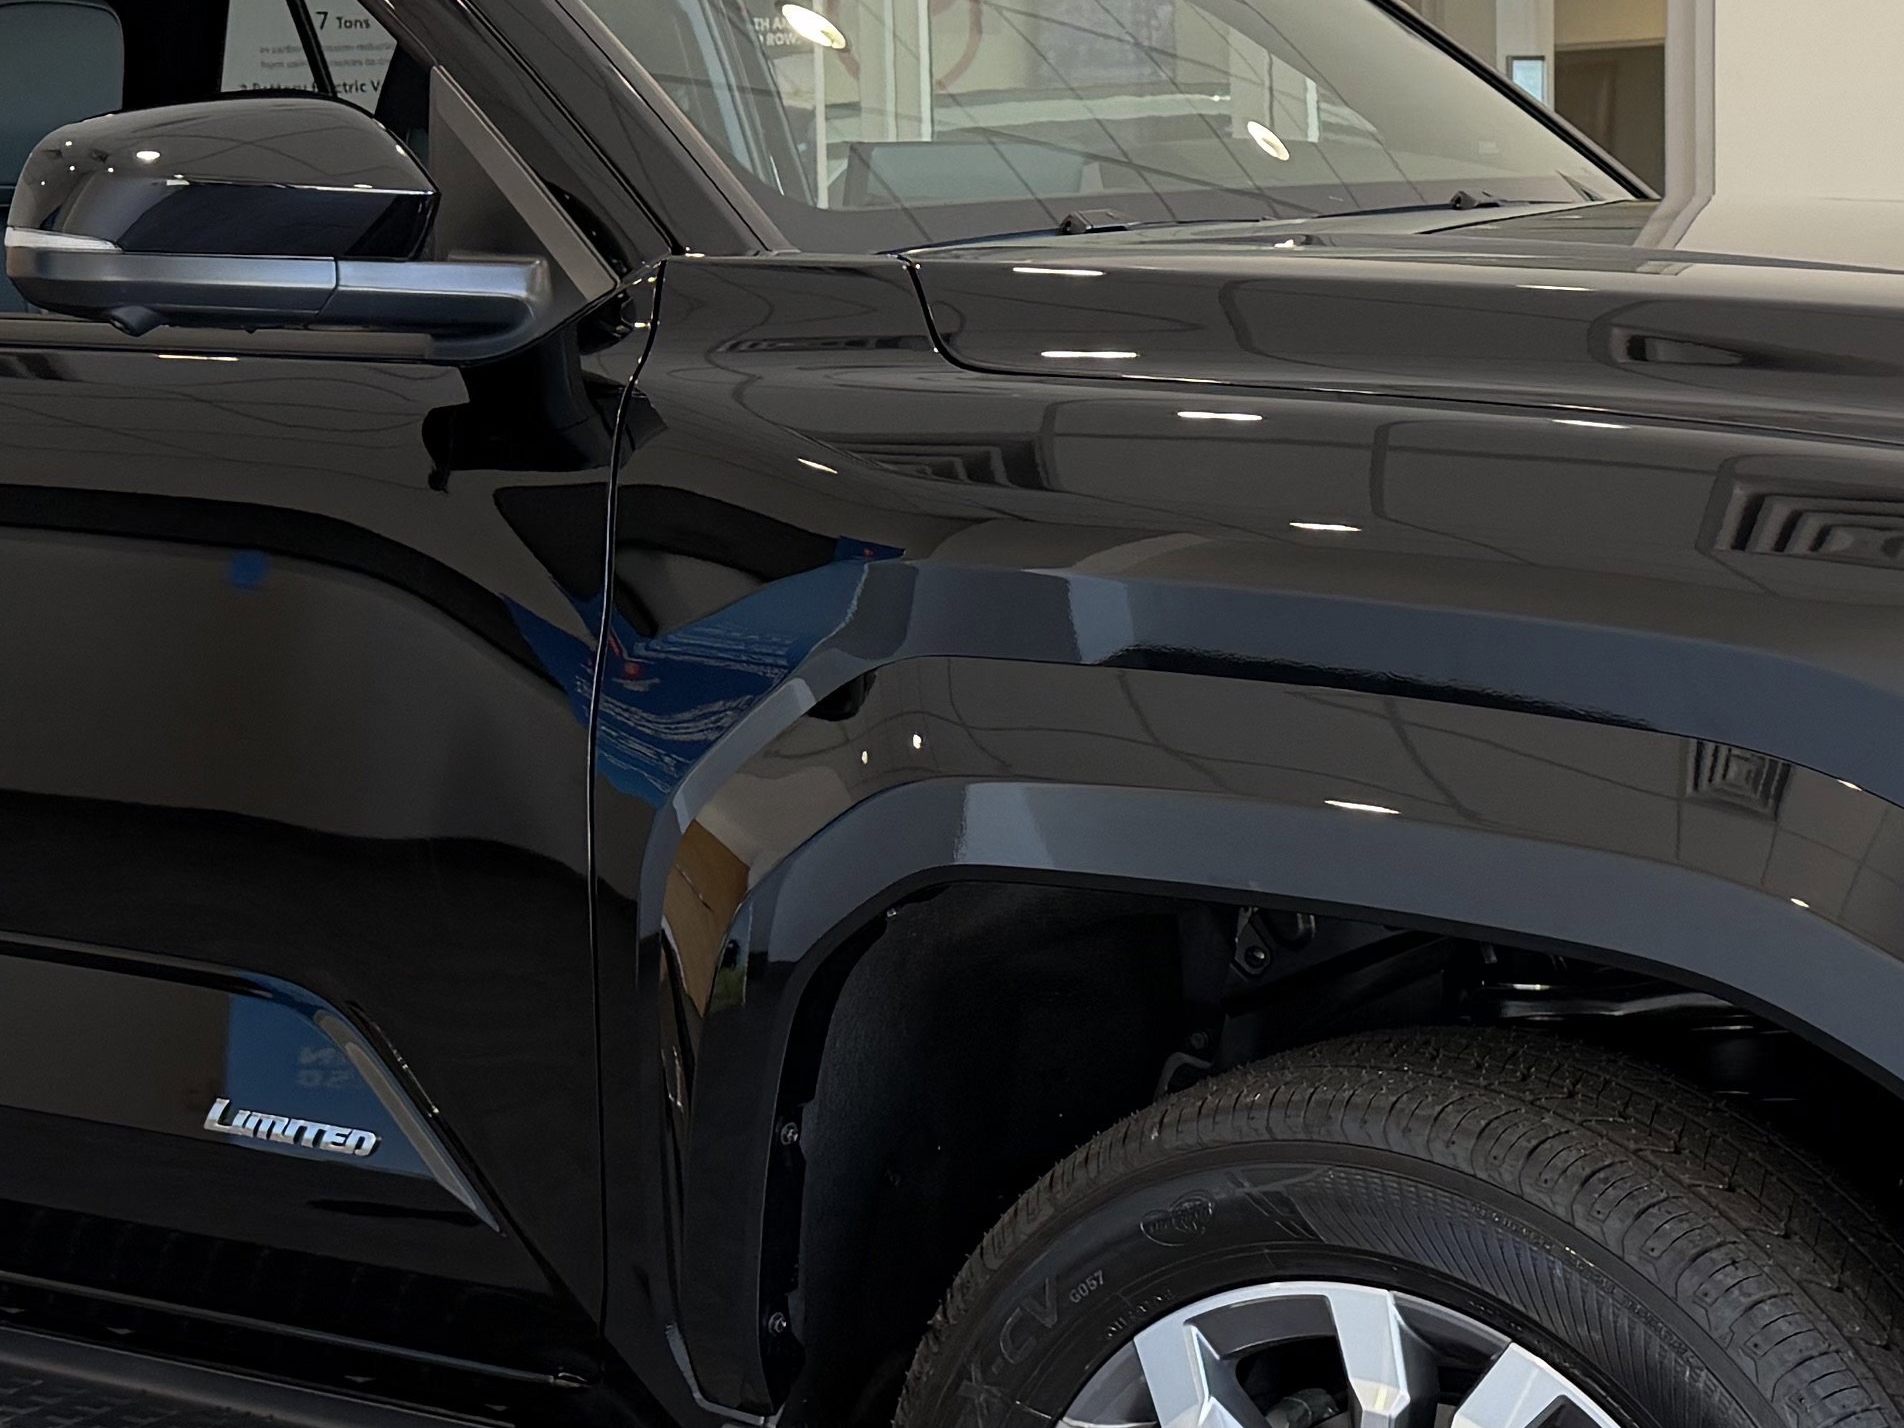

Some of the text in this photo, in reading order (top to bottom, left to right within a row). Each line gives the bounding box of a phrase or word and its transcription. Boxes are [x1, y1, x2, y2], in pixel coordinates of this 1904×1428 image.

[316, 11, 371, 30] 7 Tons
[203, 1097, 381, 1157] LIMITED
